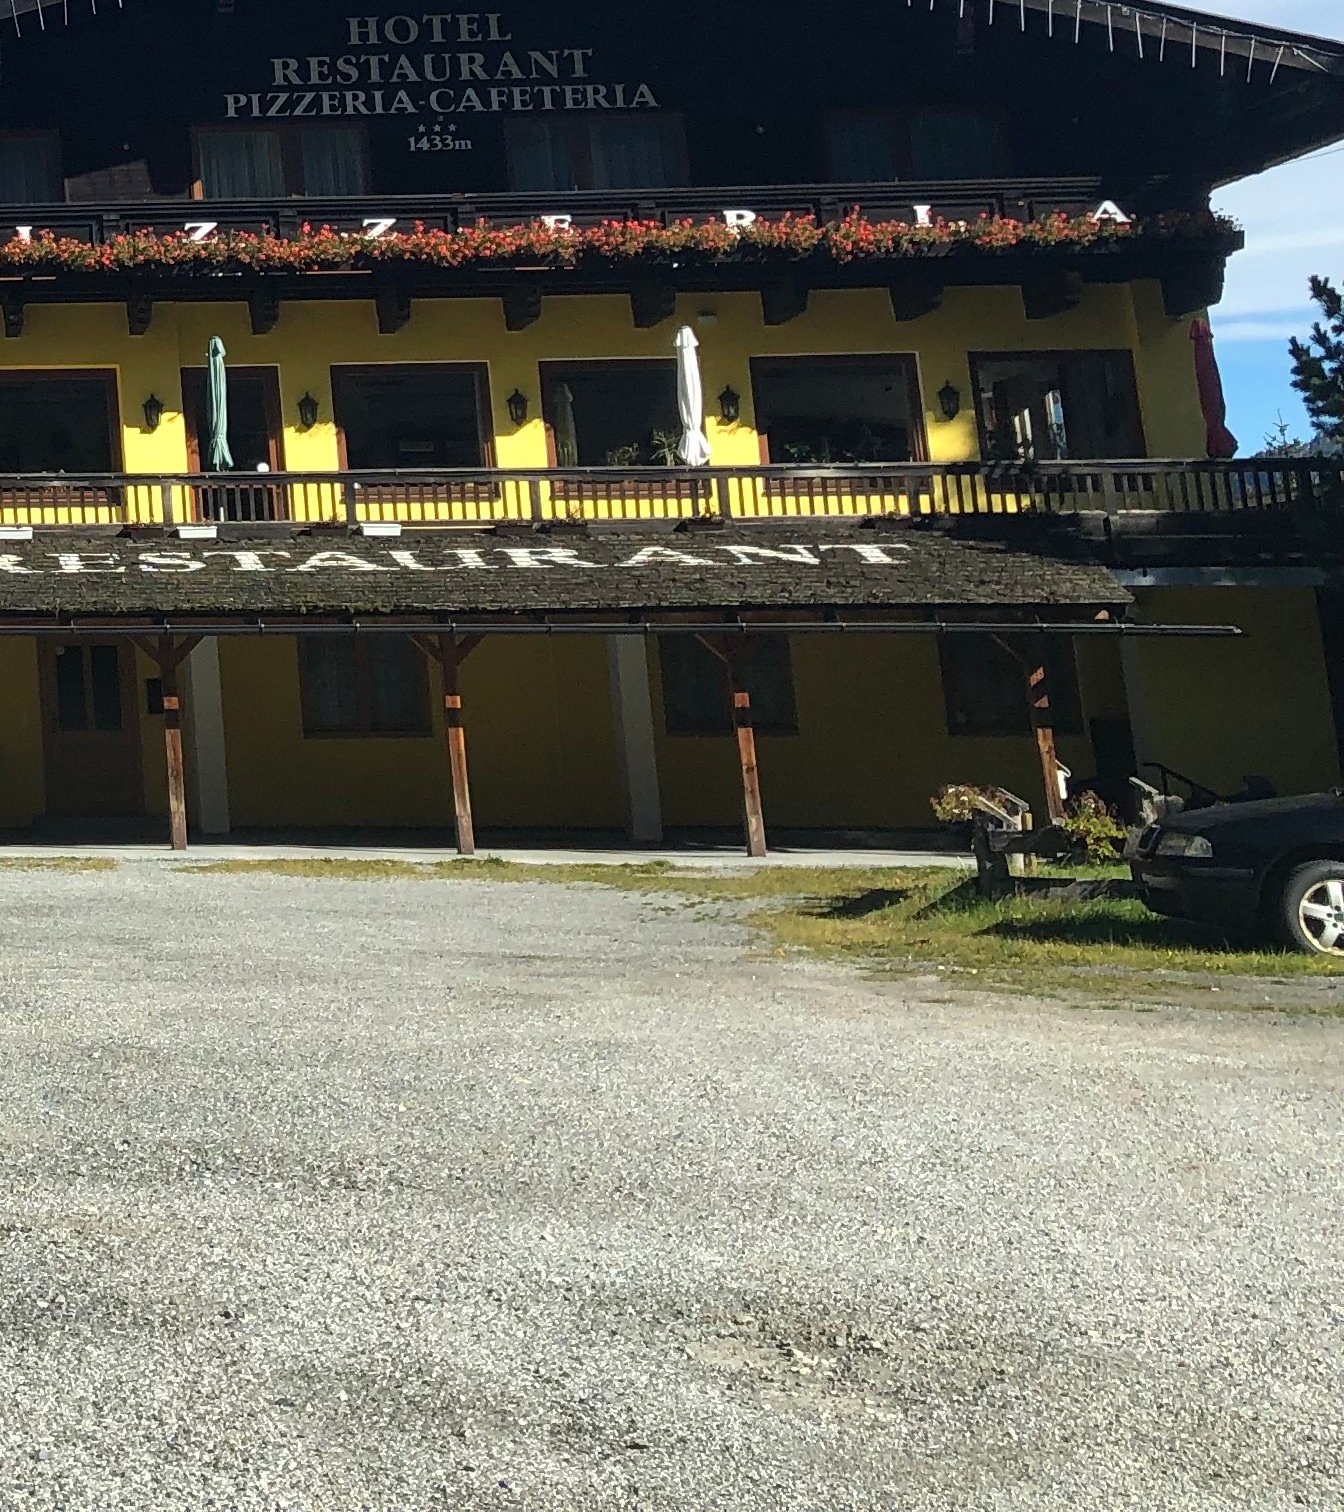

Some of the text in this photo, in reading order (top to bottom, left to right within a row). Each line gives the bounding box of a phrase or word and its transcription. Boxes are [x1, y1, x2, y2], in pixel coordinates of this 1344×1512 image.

[346, 13, 512, 45] HOTEL
[270, 48, 593, 86] RESTAURANT
[224, 82, 659, 118] PIZZERIA-CAFETERIA
[407, 134, 473, 152] 1433m
